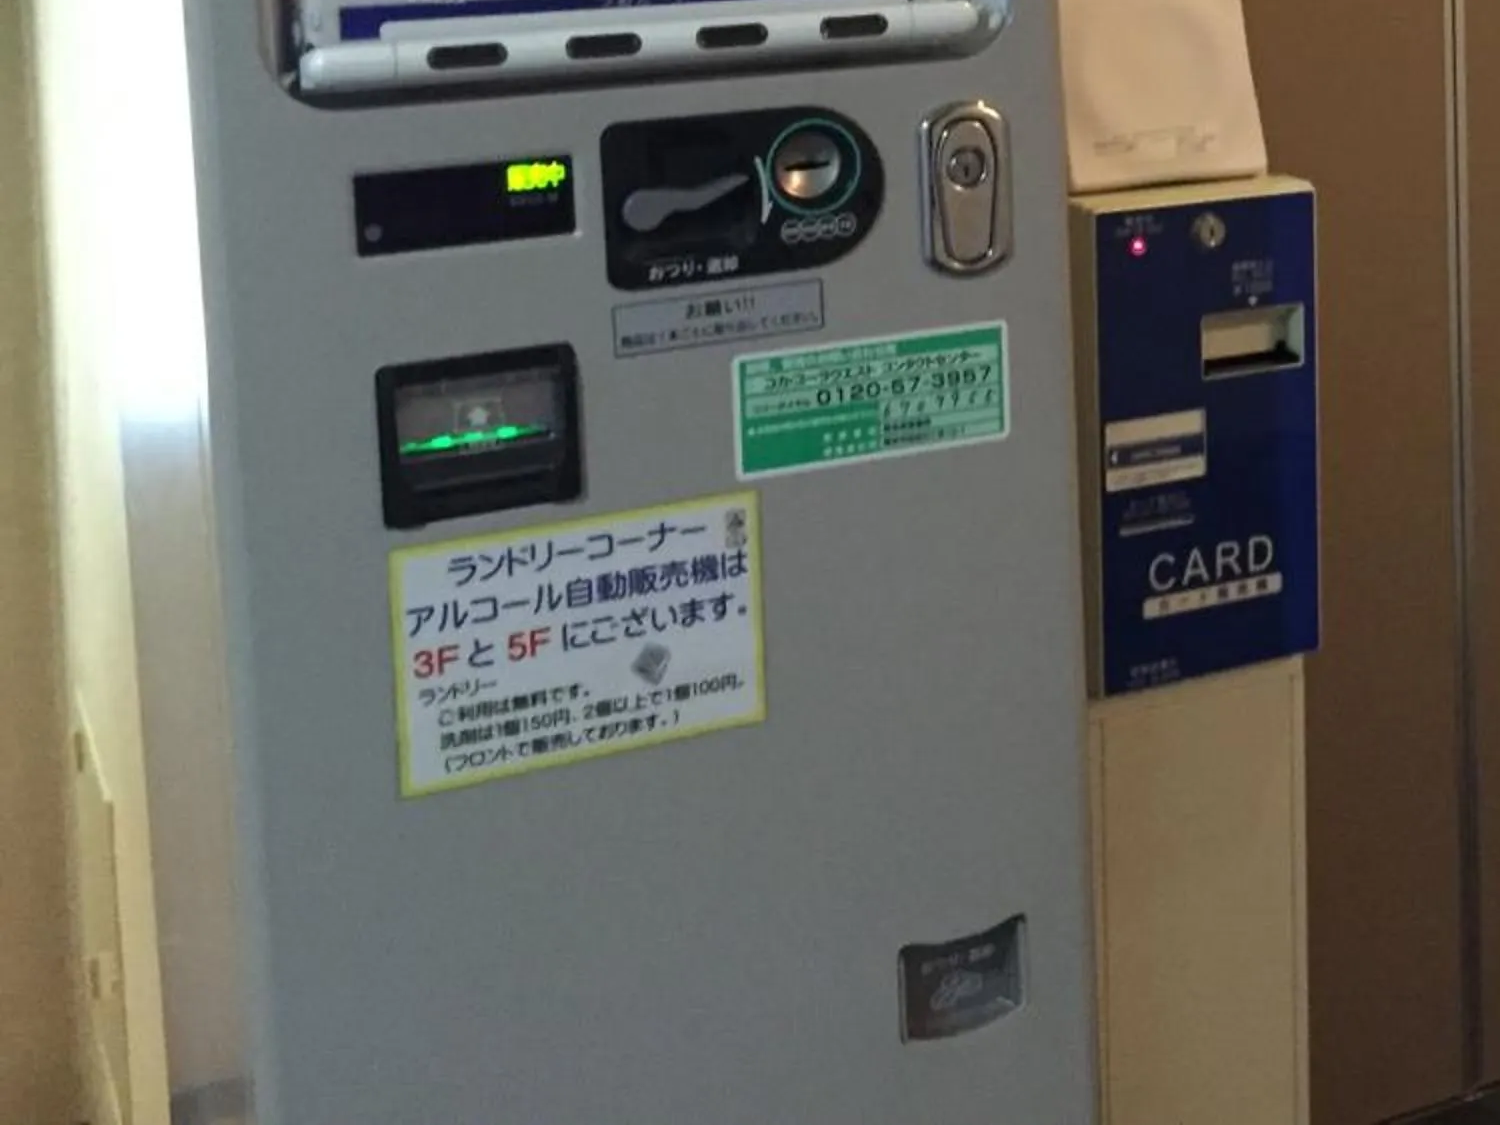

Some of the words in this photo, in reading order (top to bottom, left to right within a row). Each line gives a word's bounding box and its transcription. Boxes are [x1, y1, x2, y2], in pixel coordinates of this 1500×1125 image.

[447, 521, 707, 588] ランドリーコーナー
[1148, 535, 1275, 592] CARD
[405, 549, 748, 638] アルコール自動販売機は
[413, 644, 461, 680] 3F
[507, 626, 553, 663] 5F
